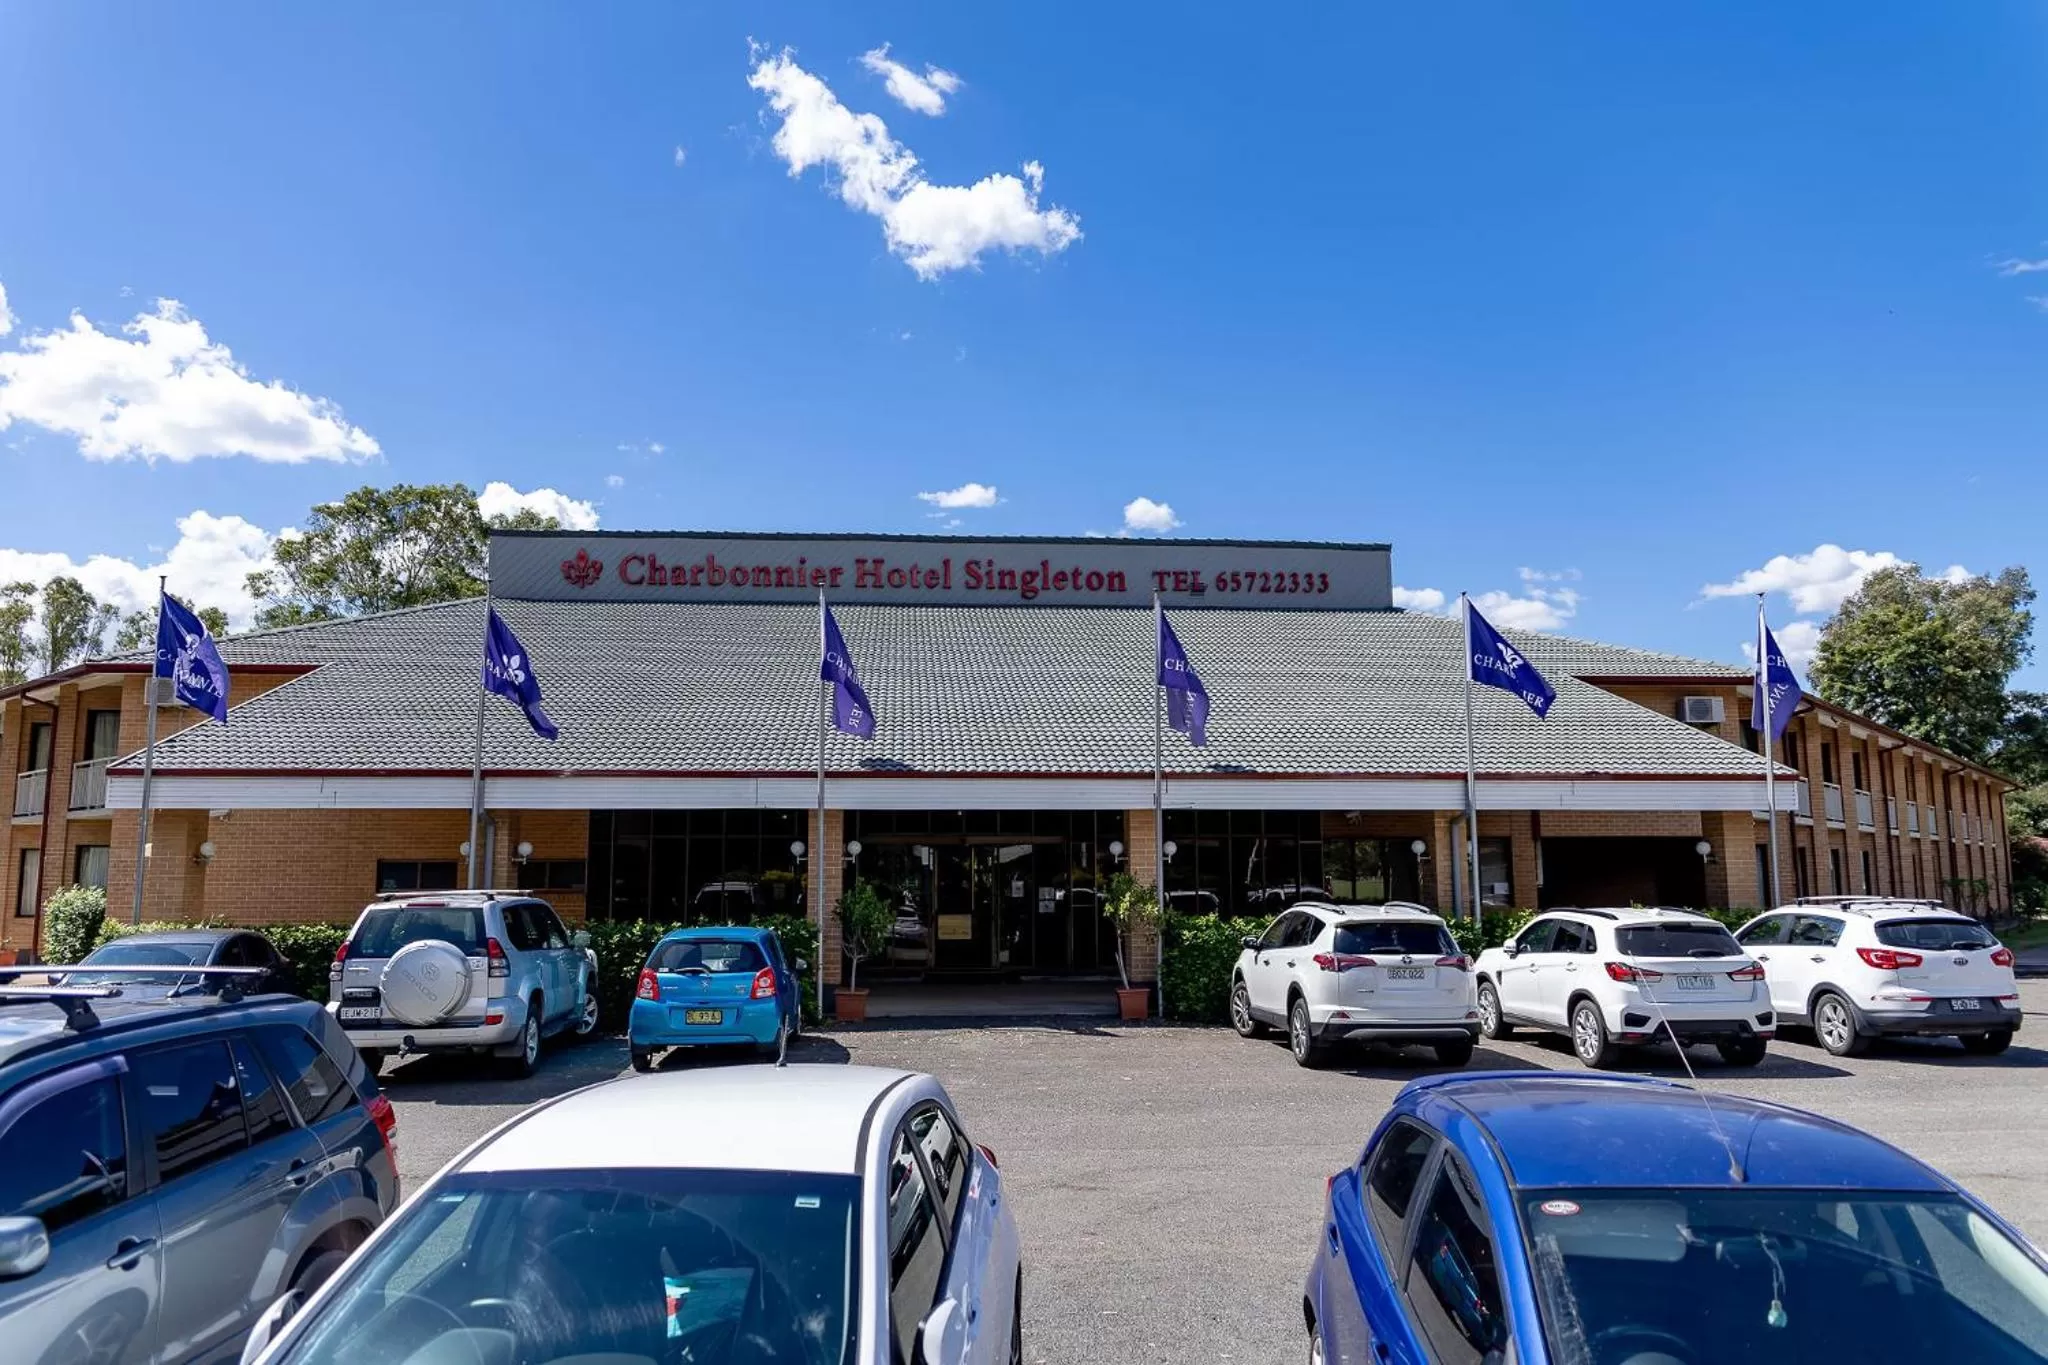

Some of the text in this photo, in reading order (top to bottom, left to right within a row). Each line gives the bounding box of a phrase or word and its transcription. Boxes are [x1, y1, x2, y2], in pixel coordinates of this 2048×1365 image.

[618, 553, 1330, 600] Charbonnier Hotel Singleton TEL 65722333
